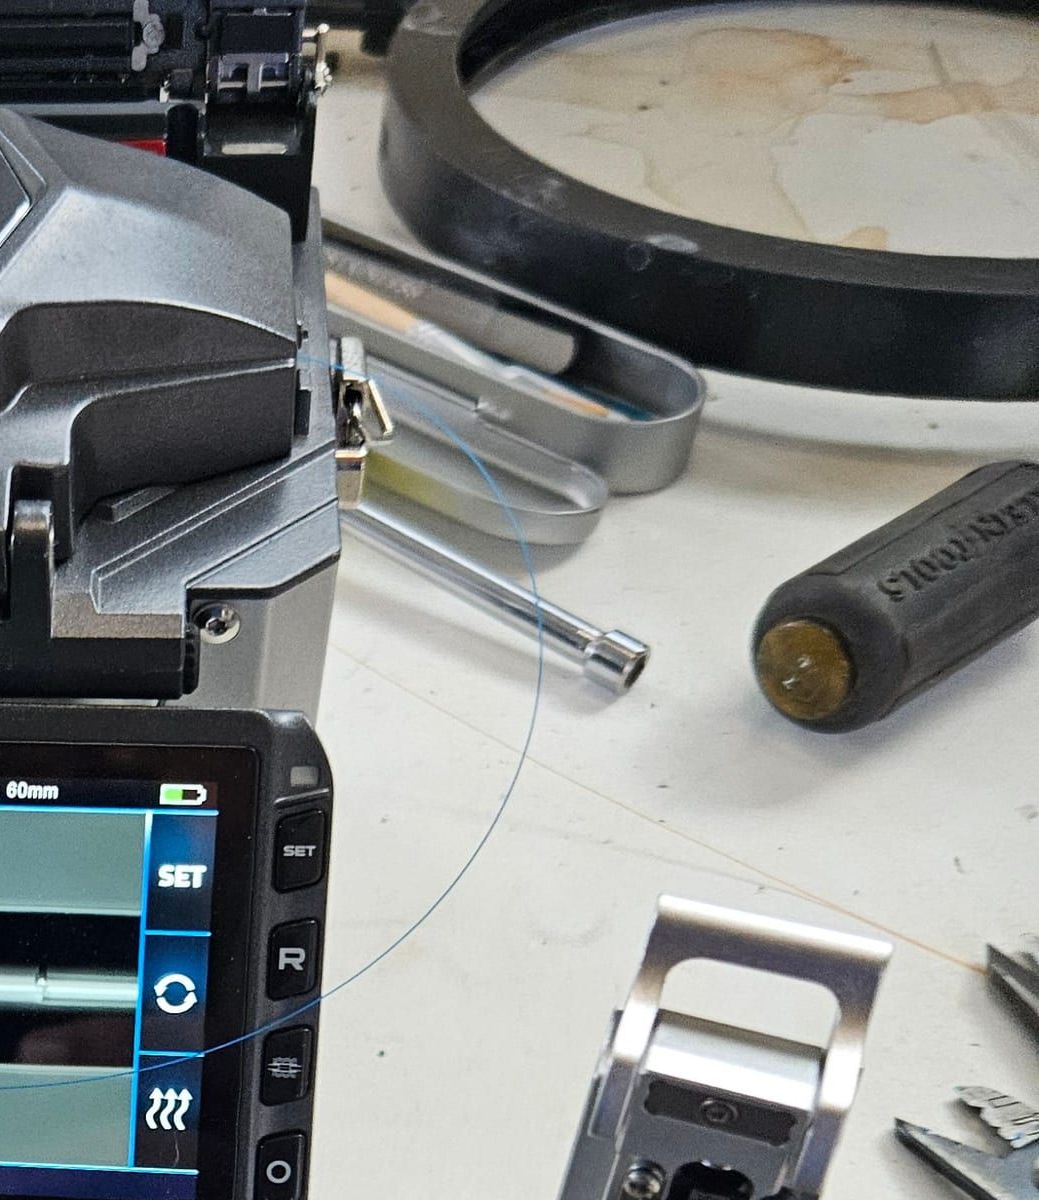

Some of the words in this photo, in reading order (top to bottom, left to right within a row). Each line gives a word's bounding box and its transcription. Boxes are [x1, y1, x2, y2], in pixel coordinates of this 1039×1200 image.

[5, 780, 59, 800] 60mm
[282, 844, 316, 857] SET
[157, 864, 207, 889] SET
[277, 947, 306, 971] R
